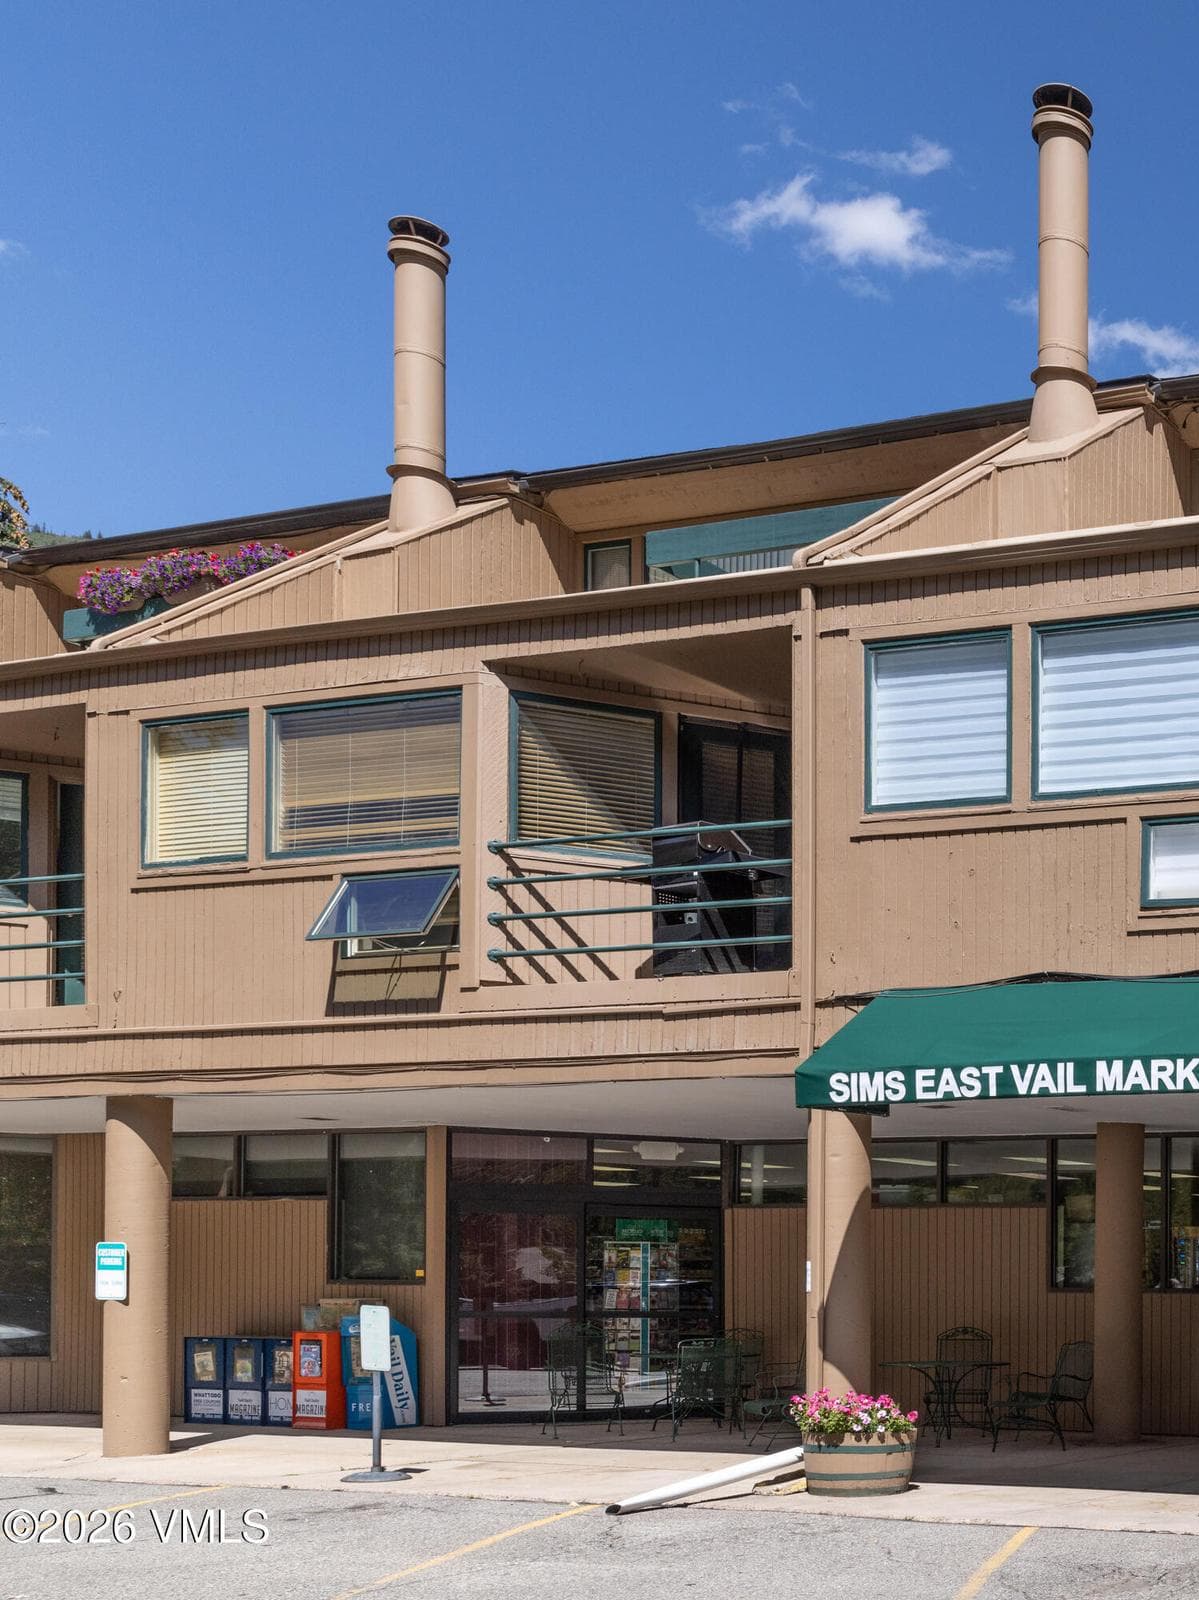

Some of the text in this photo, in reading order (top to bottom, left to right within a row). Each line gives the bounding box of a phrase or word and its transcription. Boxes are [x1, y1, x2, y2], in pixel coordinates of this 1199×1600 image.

[828, 1070, 906, 1103] SIMS
[915, 1066, 1003, 1100] EAST
[1010, 1062, 1086, 1095] VAIL
[351, 1402, 372, 1412] FRE
